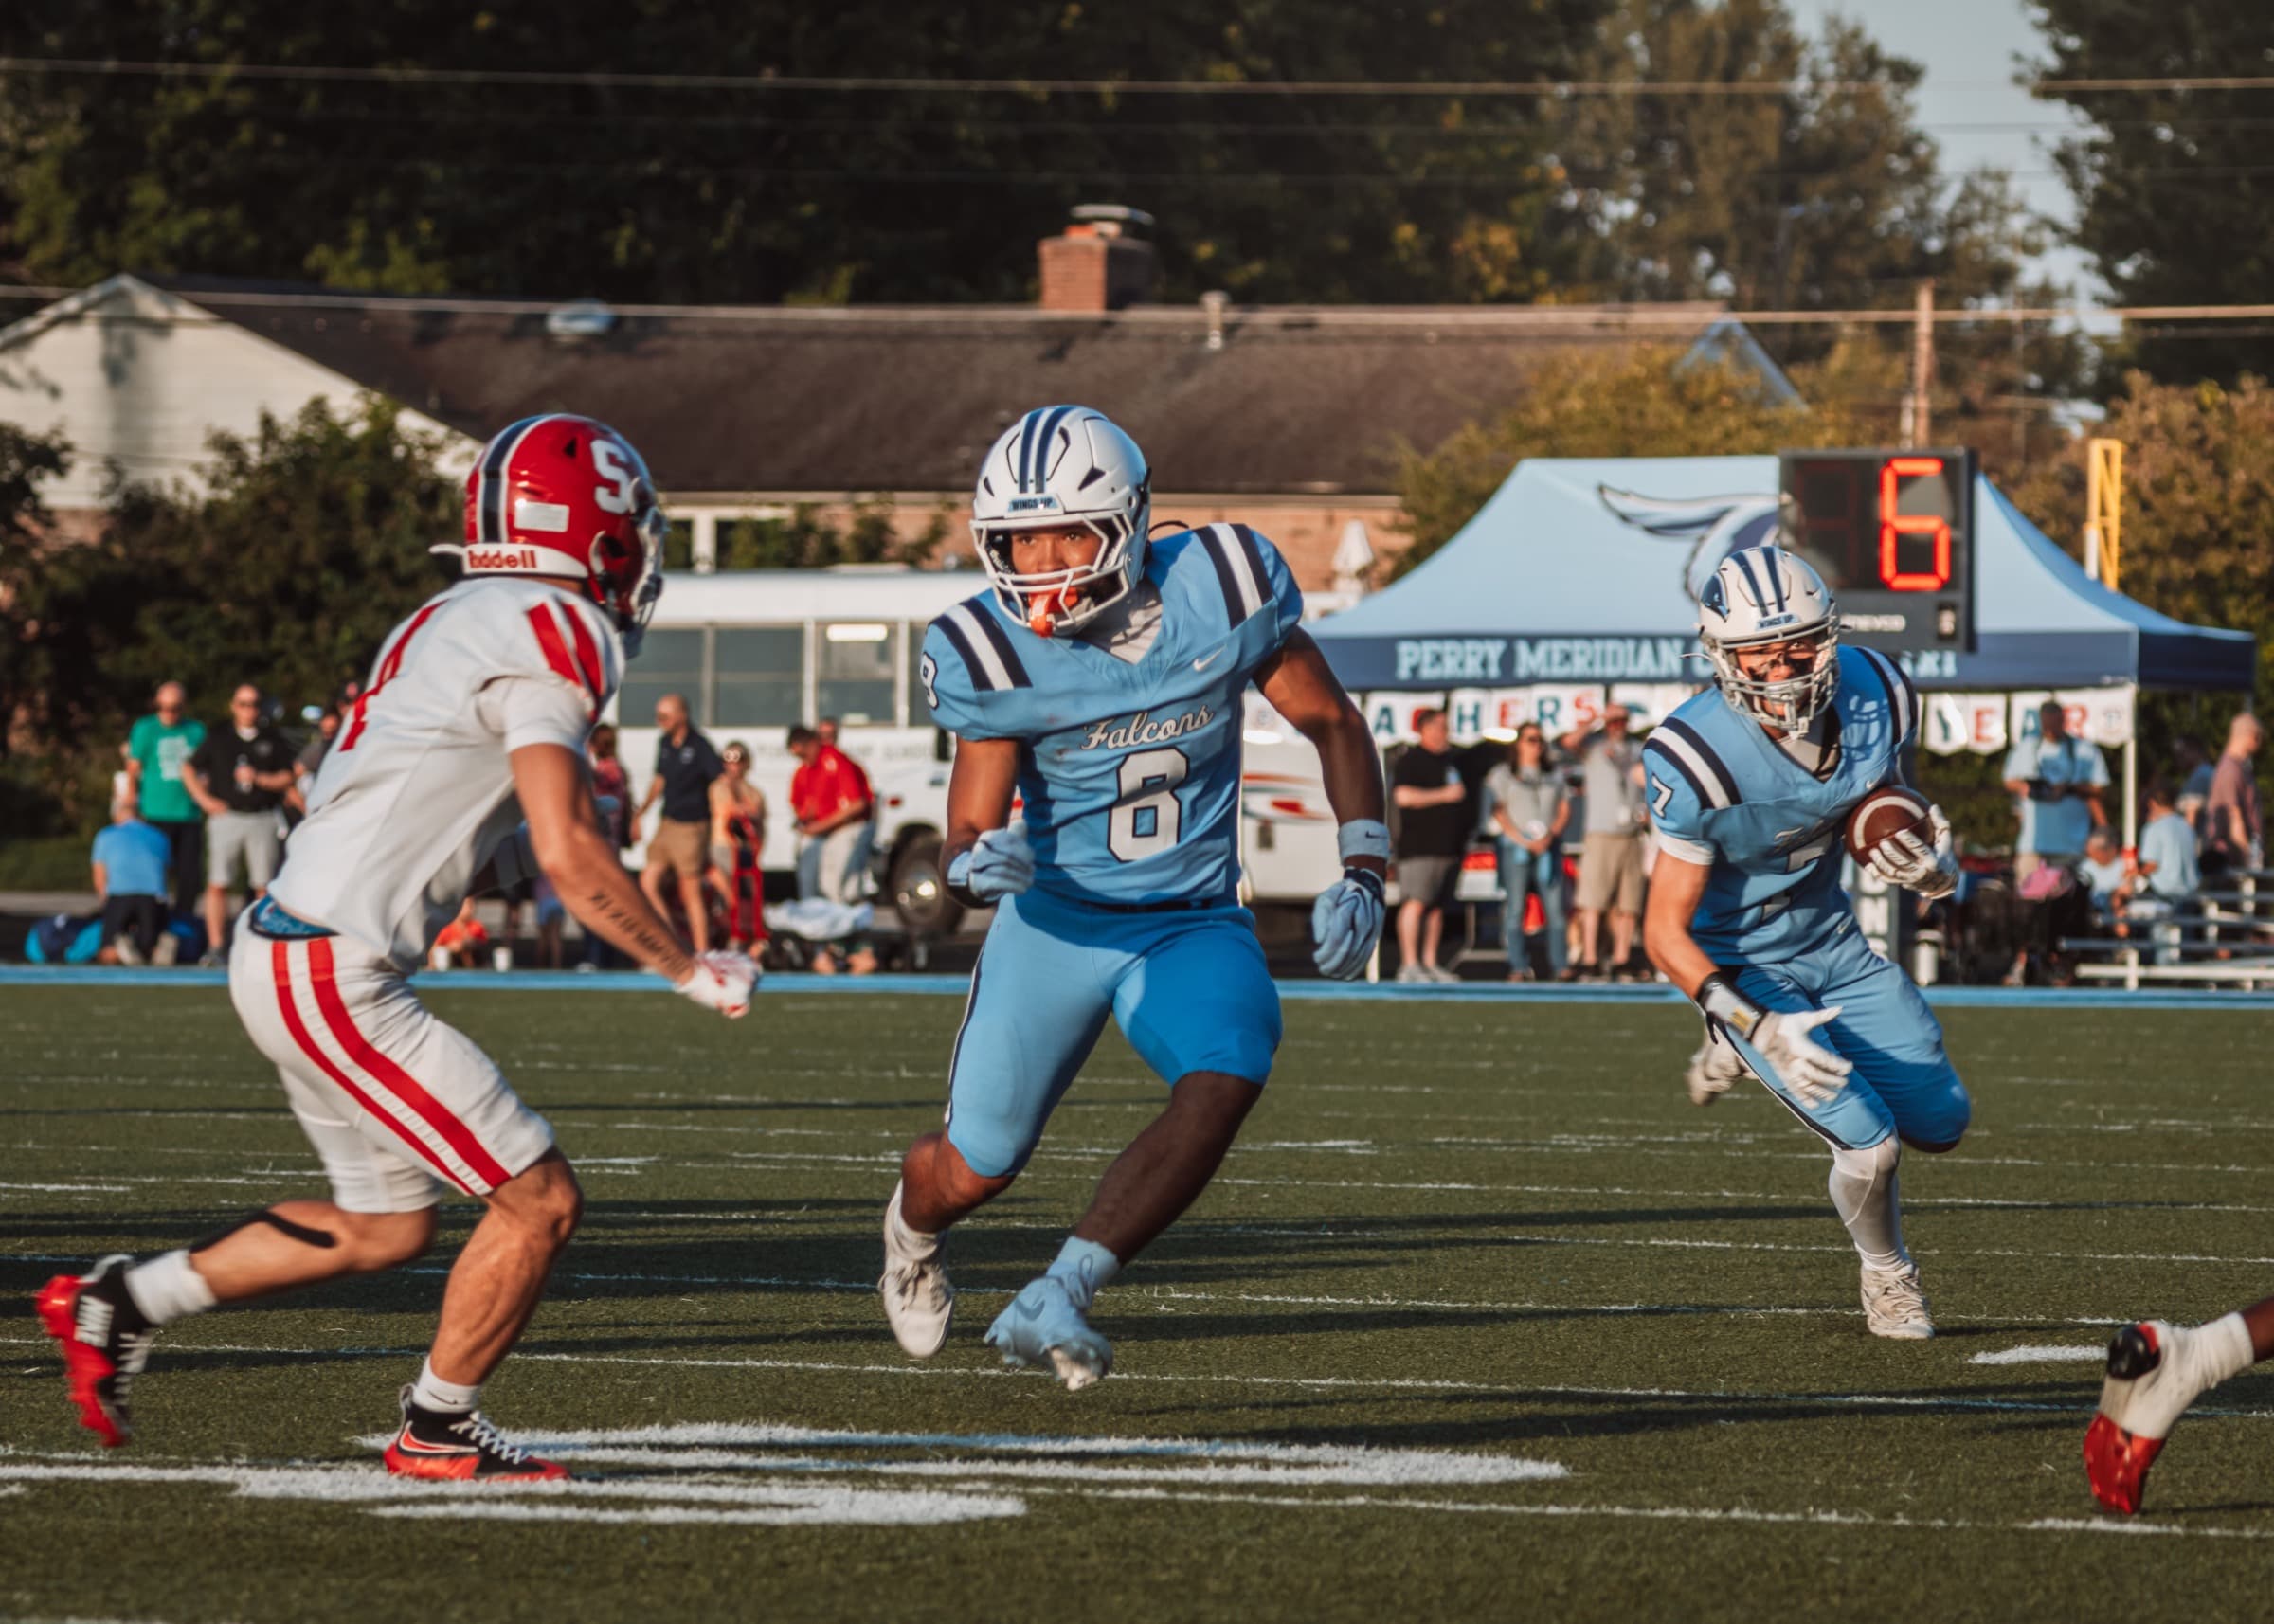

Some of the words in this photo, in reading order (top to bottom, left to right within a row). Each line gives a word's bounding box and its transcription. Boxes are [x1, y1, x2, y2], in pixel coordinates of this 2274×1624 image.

[589, 438, 633, 515] S
[1011, 498, 1038, 512] WINGS
[1878, 457, 1952, 591] 6
[1395, 640, 1507, 680] PERRY
[1514, 637, 1685, 679] MERIDIAN
[1080, 705, 1216, 751] Falcons
[1107, 744, 1191, 865] 8
[1651, 772, 1675, 820] 7
